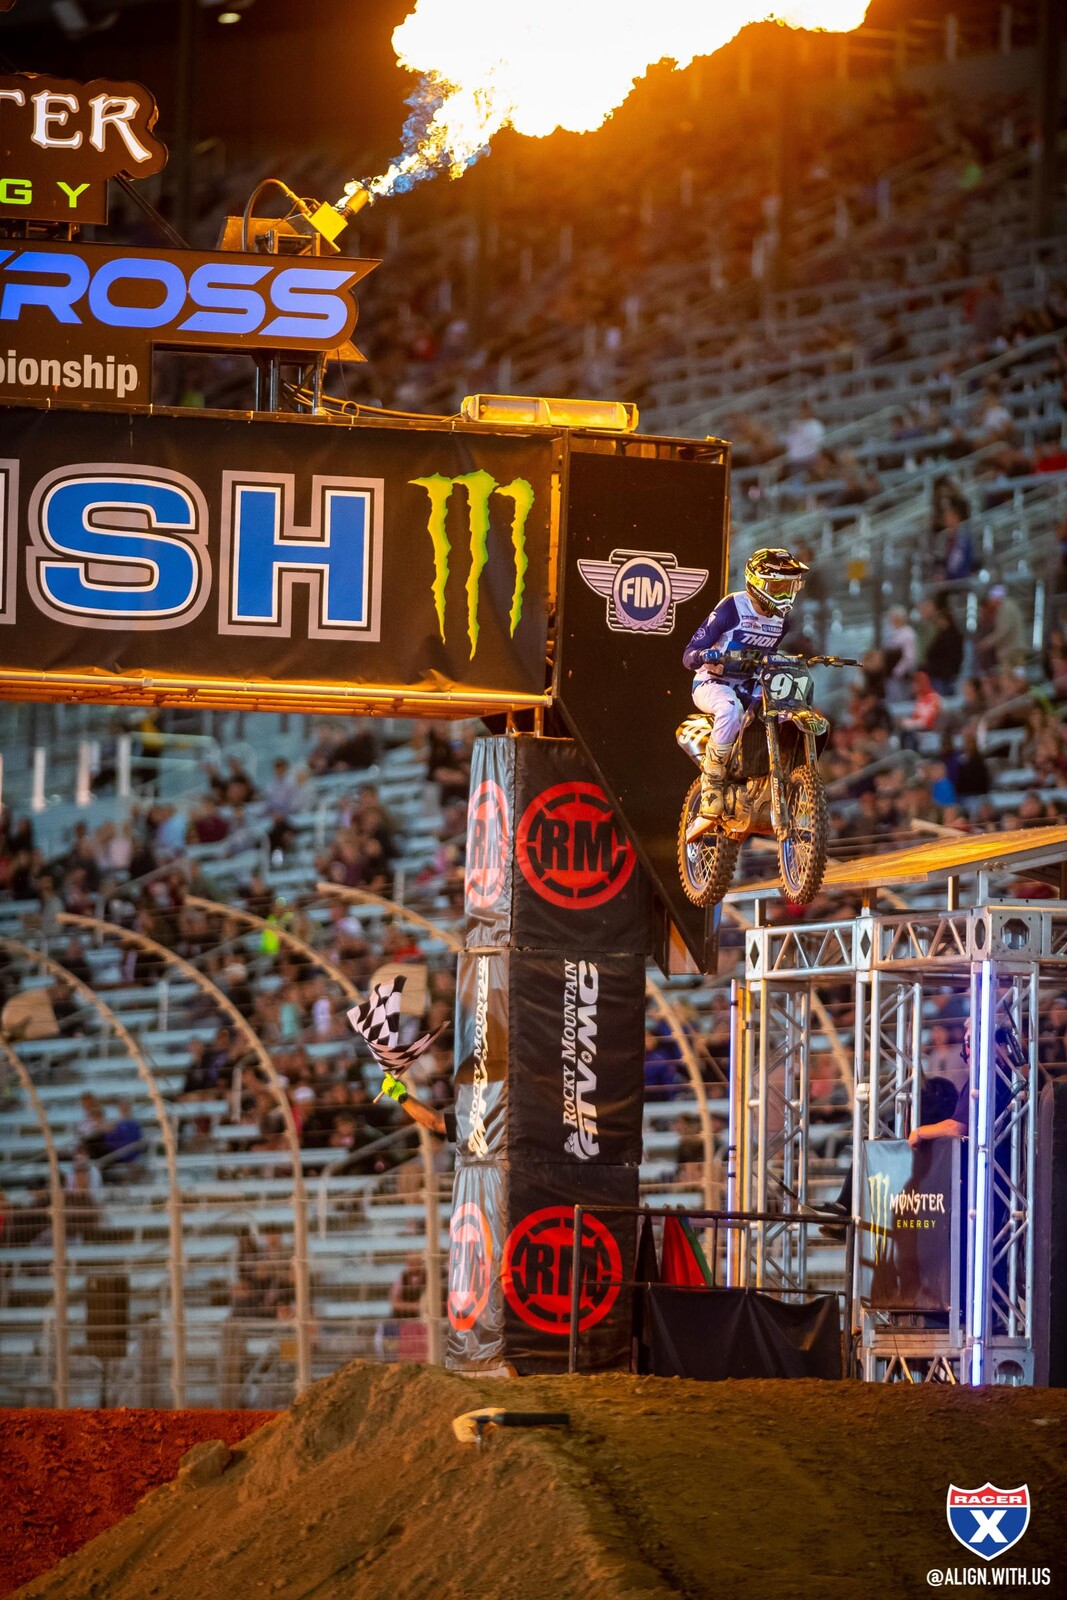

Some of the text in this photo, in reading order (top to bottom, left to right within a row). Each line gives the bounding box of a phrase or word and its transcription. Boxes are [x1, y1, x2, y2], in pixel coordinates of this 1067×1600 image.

[0, 249, 356, 339] ROSS
[0, 349, 138, 398] ionship
[0, 459, 385, 642] SH
[621, 576, 663, 608] FIM
[741, 633, 778, 648] THOR
[770, 673, 809, 700] 91
[541, 819, 614, 871] RM
[562, 958, 578, 1129] ROCKY MOUNTAIN
[897, 1219, 936, 1228] ENERGY
